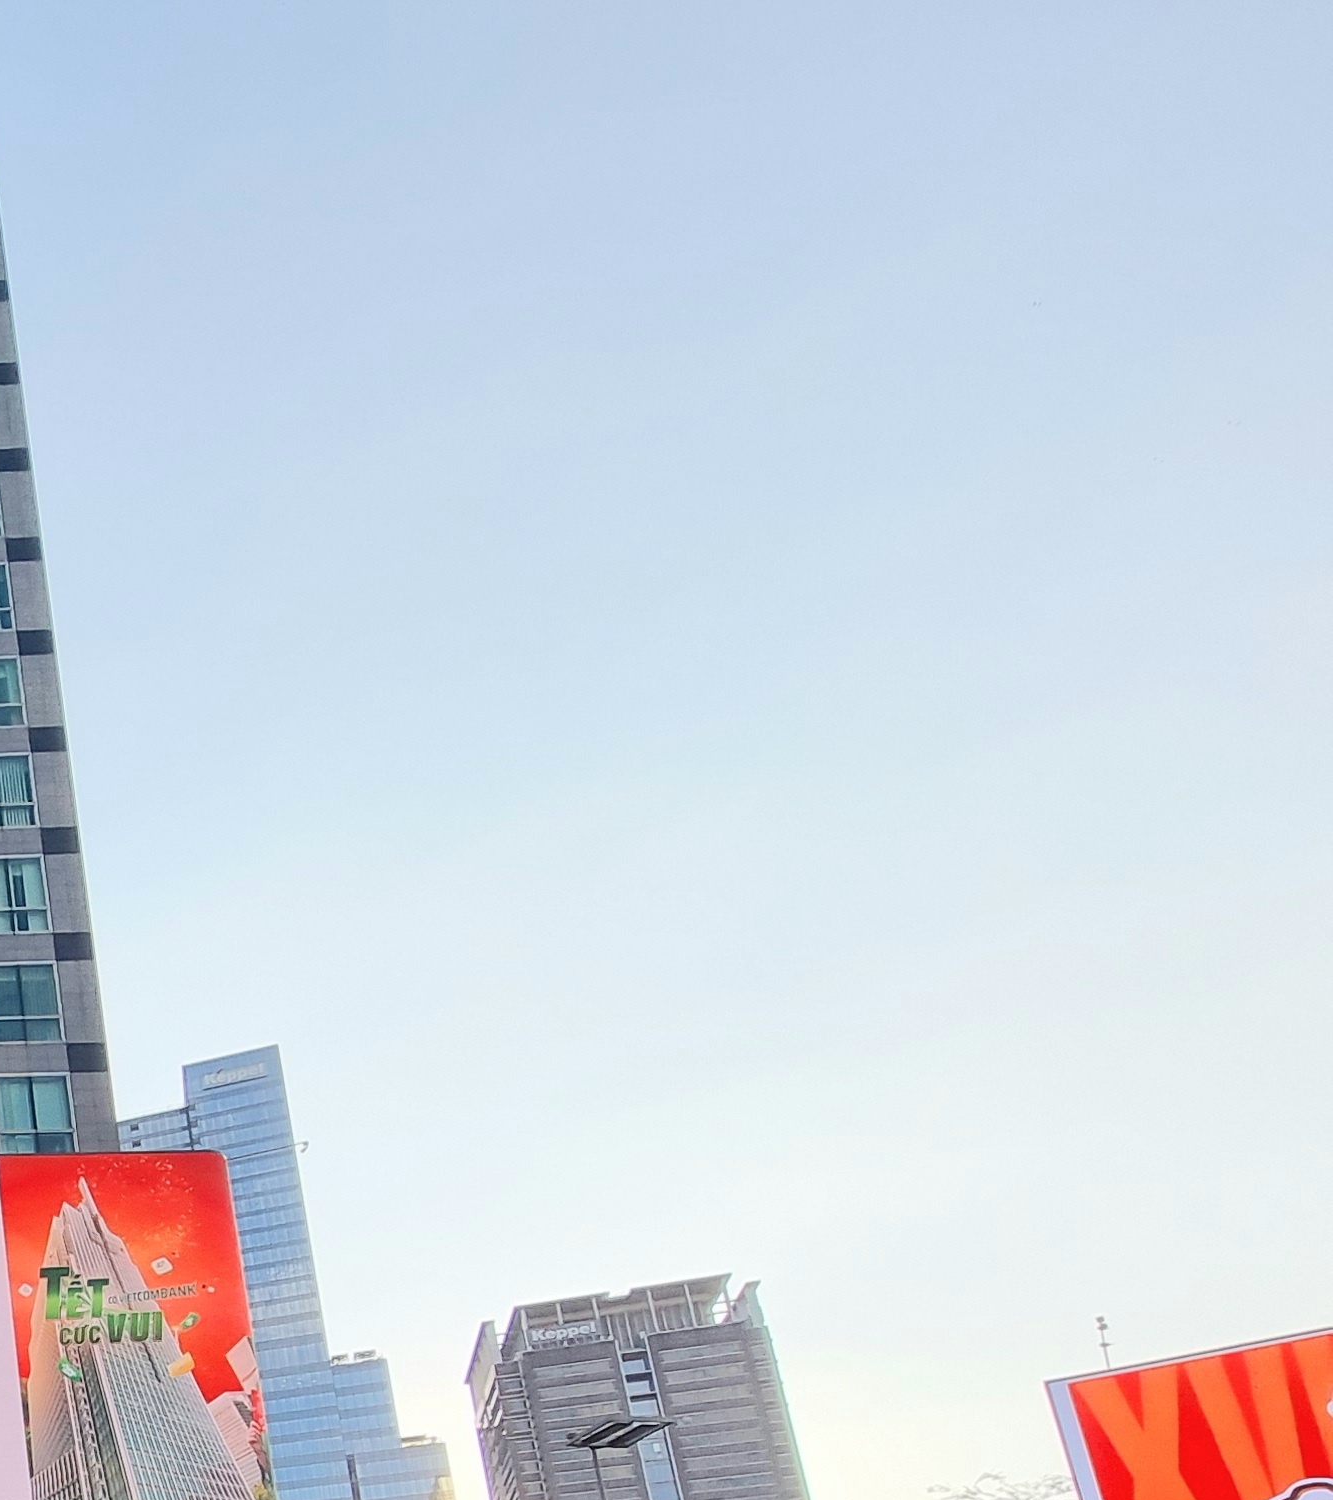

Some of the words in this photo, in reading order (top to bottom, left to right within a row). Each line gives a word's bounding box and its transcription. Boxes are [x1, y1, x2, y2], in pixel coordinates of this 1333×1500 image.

[203, 1063, 265, 1086] Keppel
[39, 1267, 110, 1319] TẾT
[120, 1284, 196, 1302] VIETCOMBANK
[107, 1312, 163, 1342] VUI
[532, 1321, 597, 1341] Keppel
